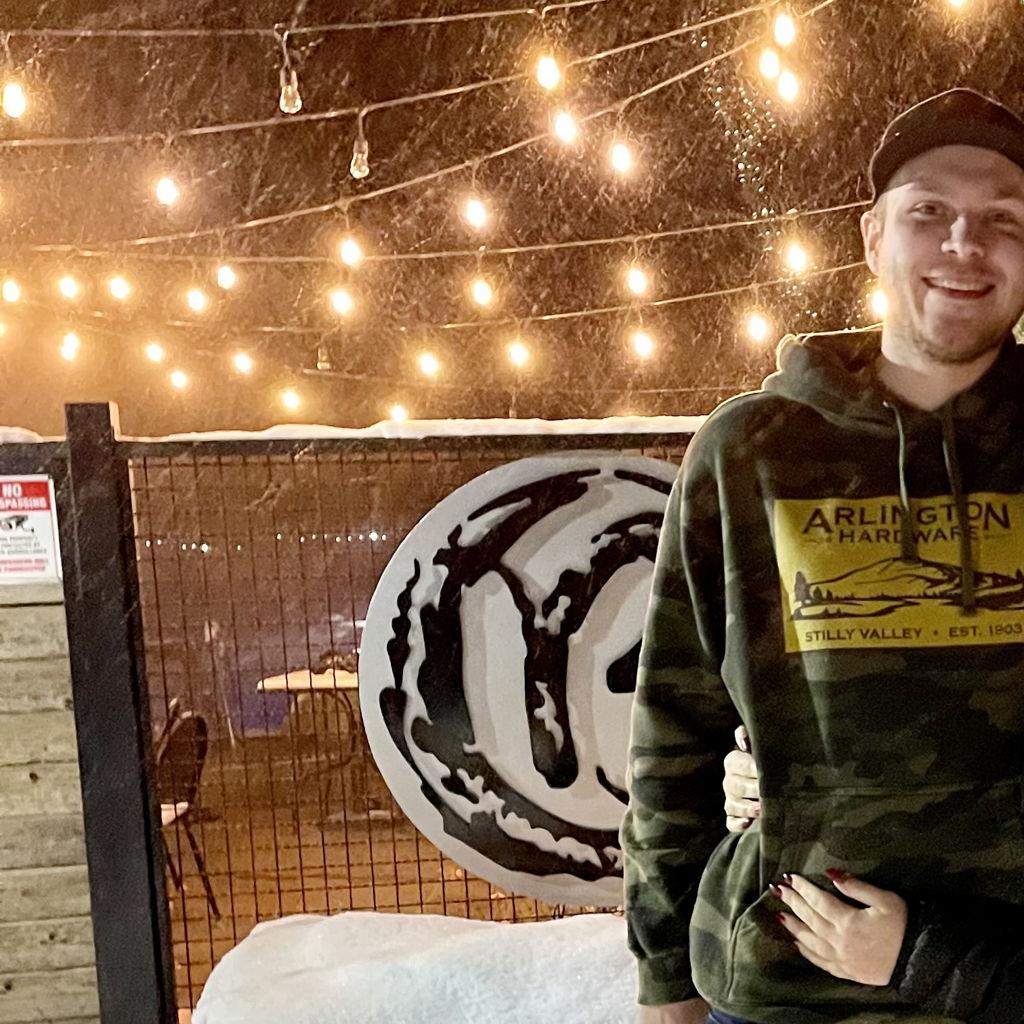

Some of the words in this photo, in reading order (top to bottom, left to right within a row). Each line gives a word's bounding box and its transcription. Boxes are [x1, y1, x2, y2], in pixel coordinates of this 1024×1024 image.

[805, 629, 855, 642] STILLY
[860, 628, 922, 640] VALLEY
[949, 625, 982, 637] EST.
